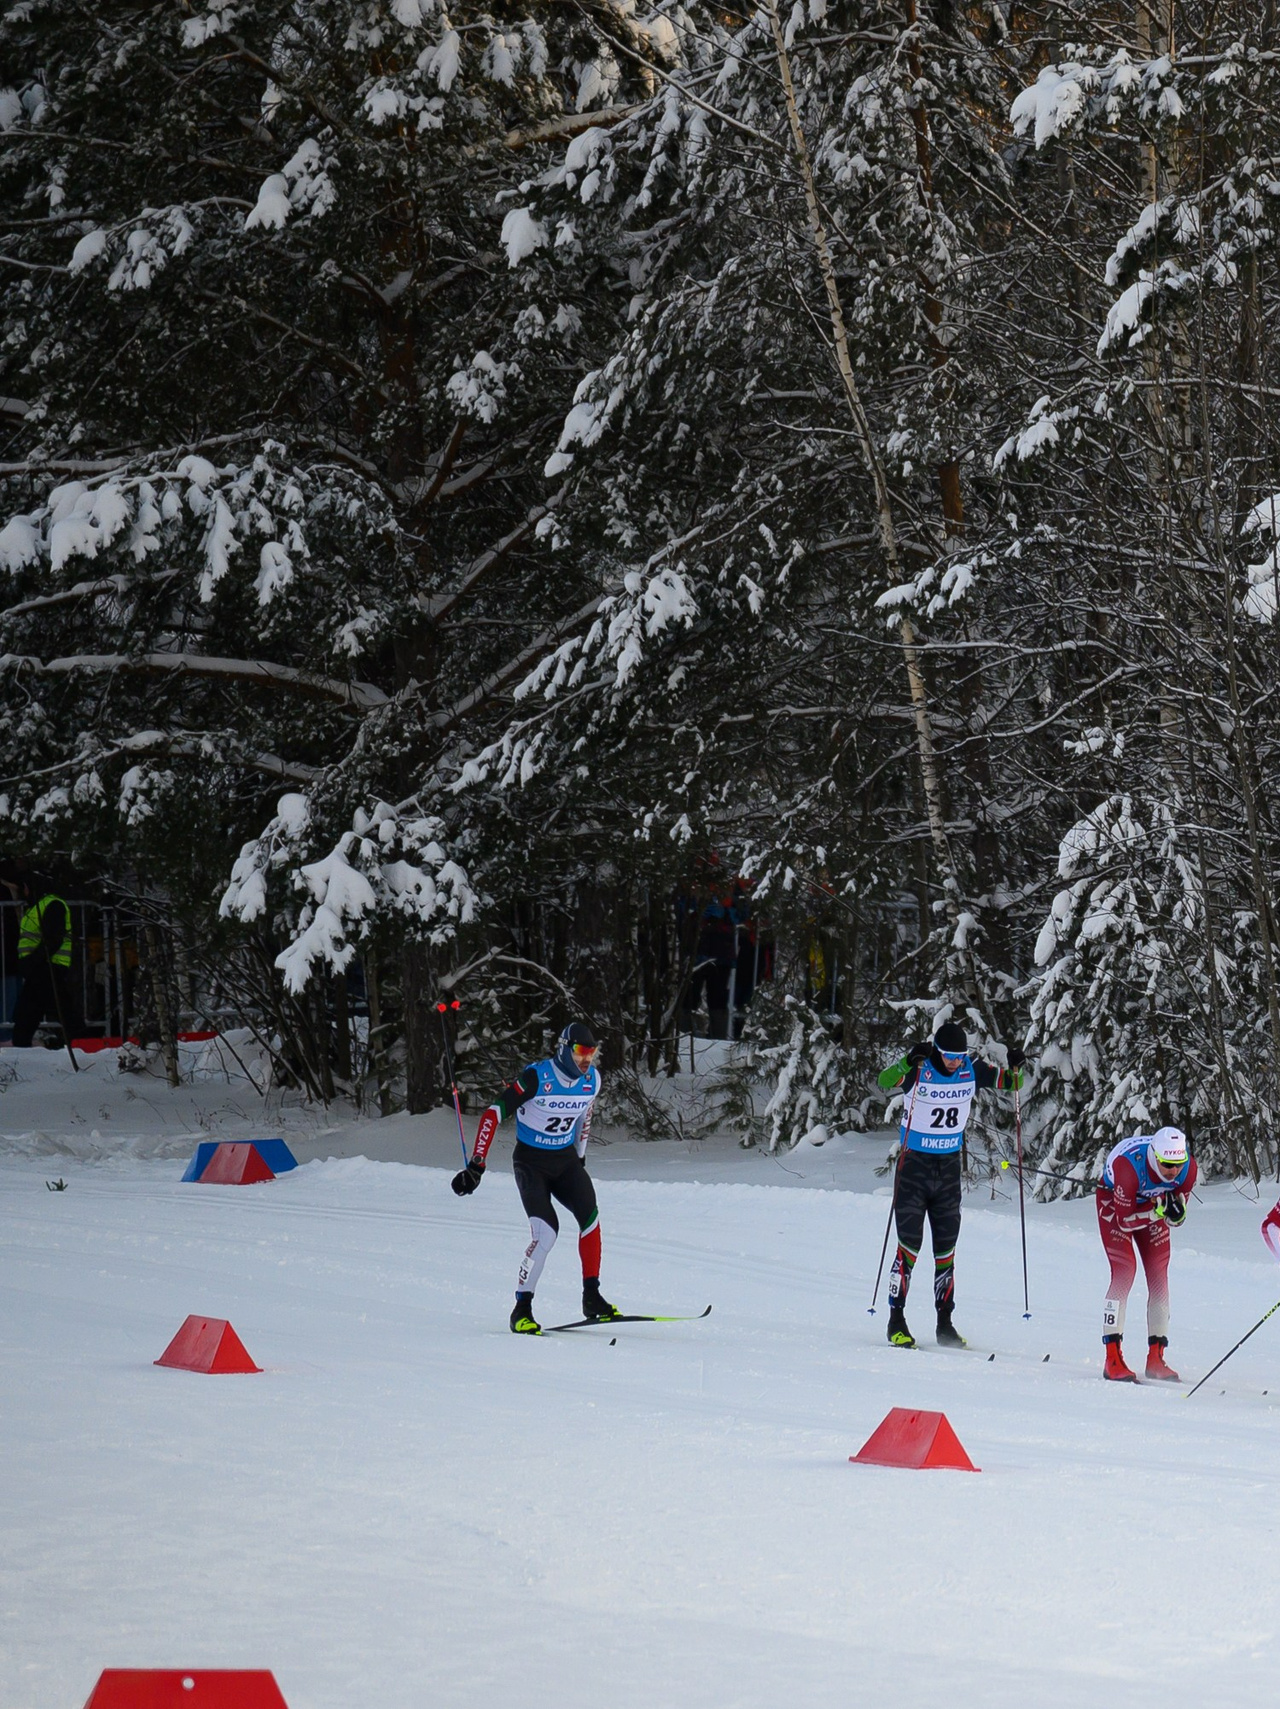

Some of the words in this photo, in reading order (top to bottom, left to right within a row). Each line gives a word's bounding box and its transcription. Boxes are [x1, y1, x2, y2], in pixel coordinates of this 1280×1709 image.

[930, 1088, 972, 1099] ФОСАГРО
[544, 1116, 575, 1133] 23
[929, 1107, 959, 1129] 28
[476, 1118, 493, 1155] KAZAN
[921, 1136, 960, 1149] ИЖЕВСК
[1104, 1312, 1116, 1325] 18
